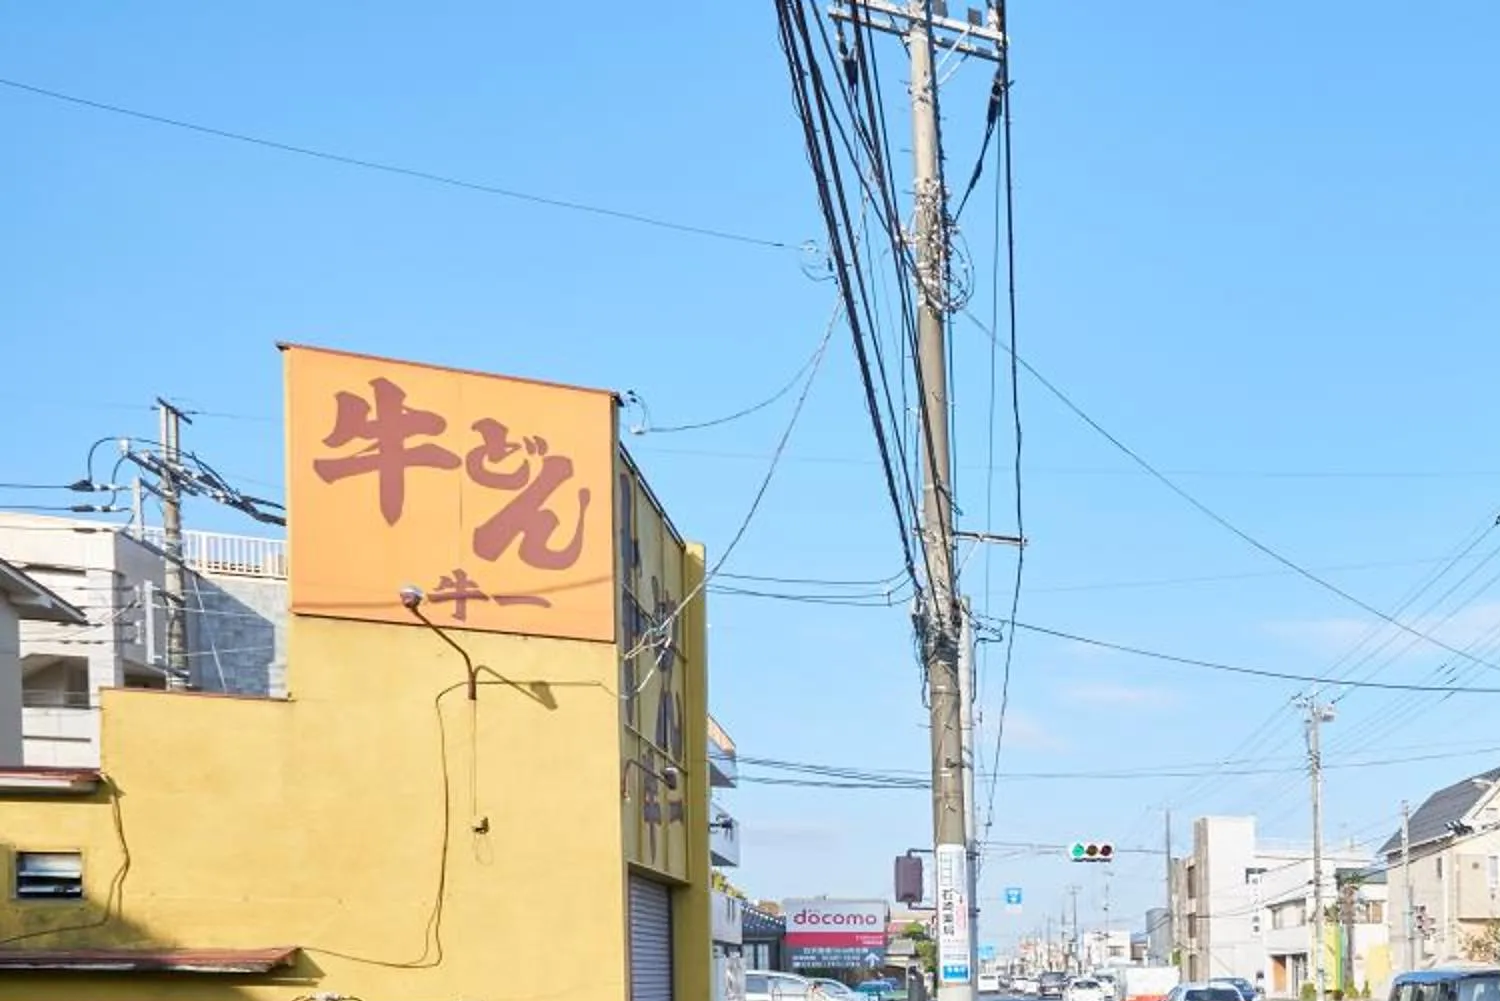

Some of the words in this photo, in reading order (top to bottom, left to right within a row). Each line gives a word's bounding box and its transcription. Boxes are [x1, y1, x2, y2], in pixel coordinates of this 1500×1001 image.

[313, 376, 591, 570] 牛どん
[427, 568, 551, 621] 牛一
[793, 908, 877, 924] docomo
